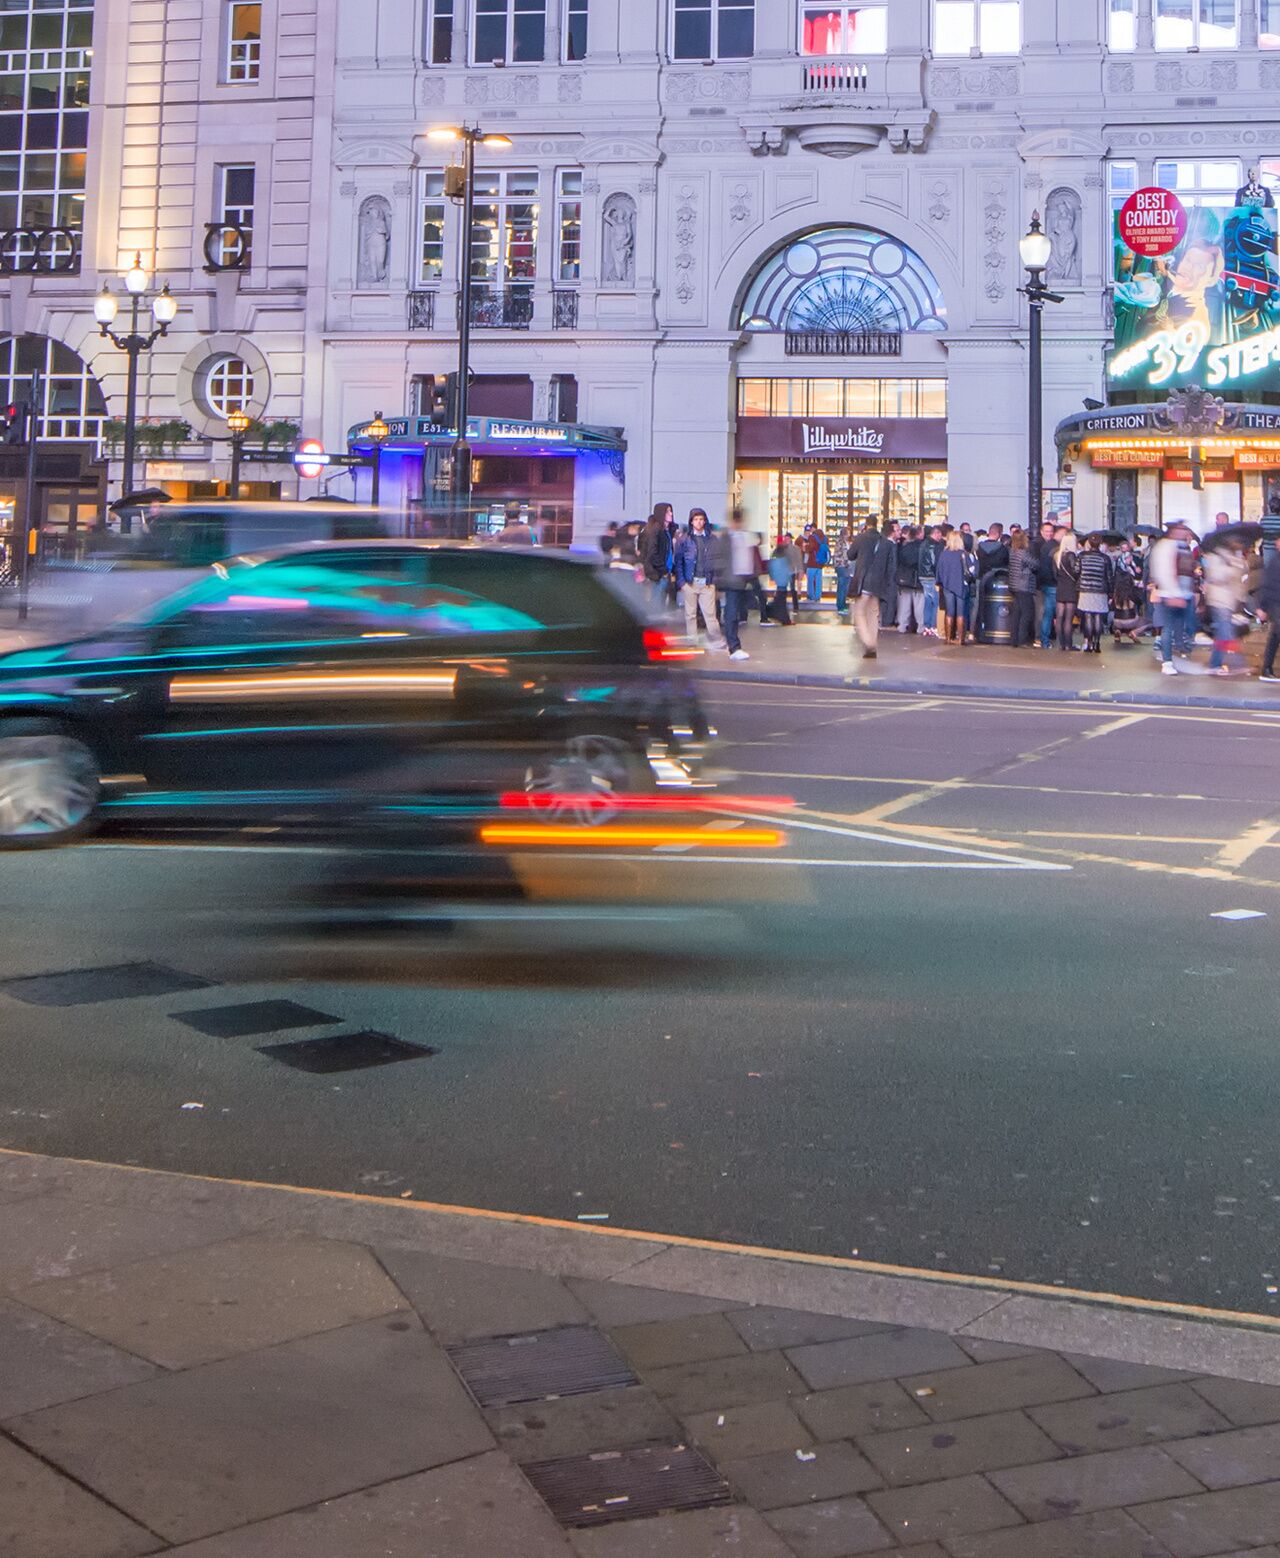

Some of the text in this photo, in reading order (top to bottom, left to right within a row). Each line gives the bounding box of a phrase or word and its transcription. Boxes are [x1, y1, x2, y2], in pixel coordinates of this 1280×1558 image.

[1136, 192, 1167, 210] BEST
[1125, 209, 1178, 227] COMEDY
[1147, 227, 1166, 235] AWARD
[1150, 235, 1173, 243] AWARDS
[1148, 320, 1210, 385] 39
[491, 423, 565, 437] RESTAURANT
[1087, 414, 1145, 430] CRITERION
[802, 423, 884, 453] Lillywhites
[1239, 453, 1258, 463] BEST
[1258, 453, 1275, 463] NEW
